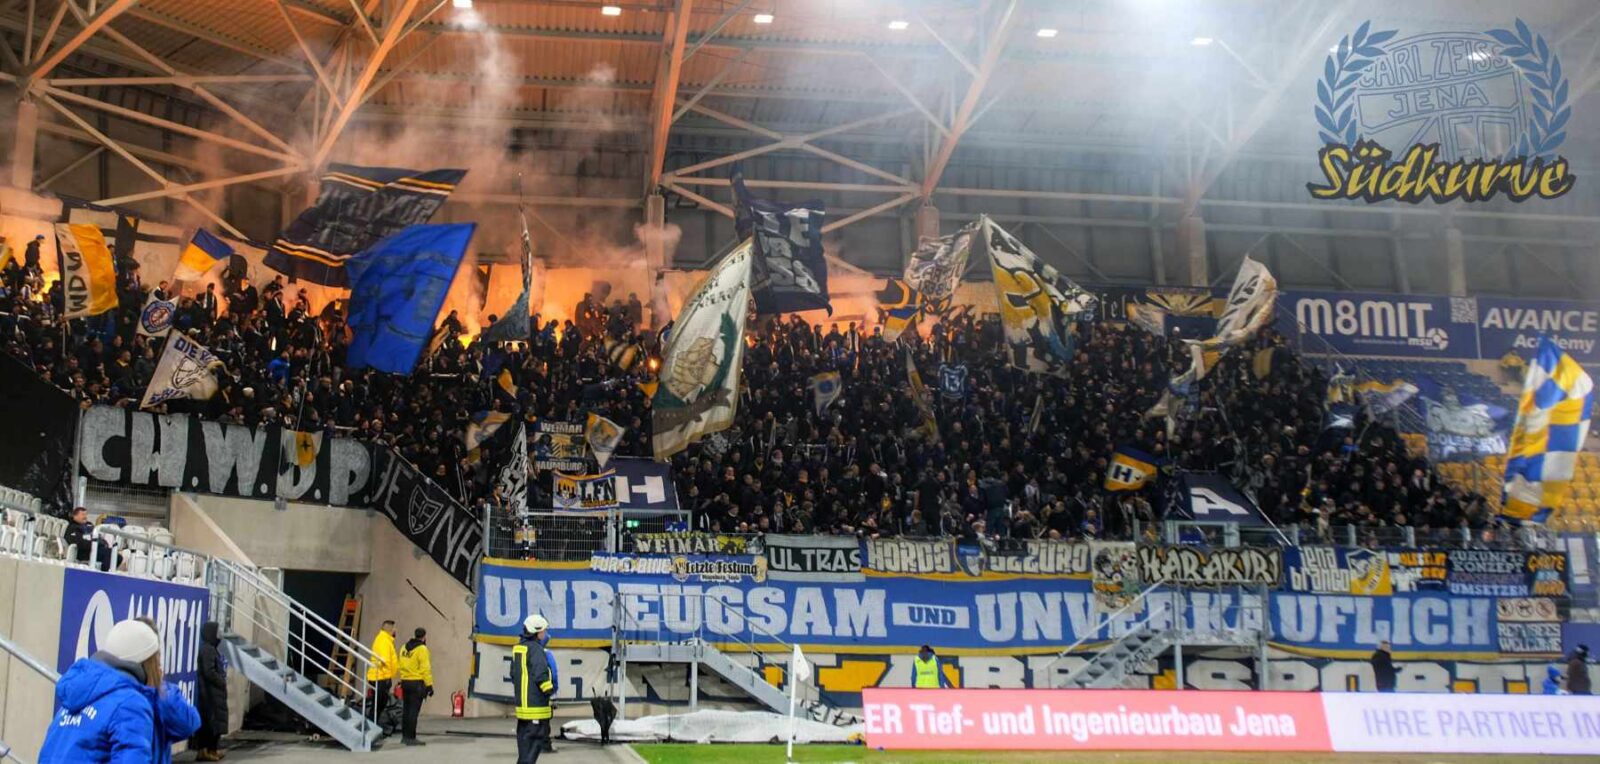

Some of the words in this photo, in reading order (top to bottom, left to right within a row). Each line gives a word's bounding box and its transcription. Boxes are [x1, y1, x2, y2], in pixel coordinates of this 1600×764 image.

[1482, 307, 1599, 332] AVANCE
[1408, 338, 1433, 346] msu
[1513, 333, 1595, 353] Acemy
[540, 422, 583, 434] WEIMAR
[1190, 487, 1249, 514] A
[636, 537, 722, 553] WEIMAR
[770, 549, 861, 572] ULTRAS
[1138, 546, 1281, 584] HARAKIRI
[1451, 582, 1528, 596] UMSETZEN
[484, 575, 888, 638] UNBEUGSAM
[909, 605, 957, 627] UND
[867, 704, 902, 734] ER
[910, 703, 973, 735] Tief-
[982, 706, 1034, 735] und
[1043, 705, 1222, 742] Ingenieurbau
[1230, 704, 1296, 737] Jena
[1363, 709, 1431, 737] IHRE
[1439, 710, 1567, 738] PARTNER
